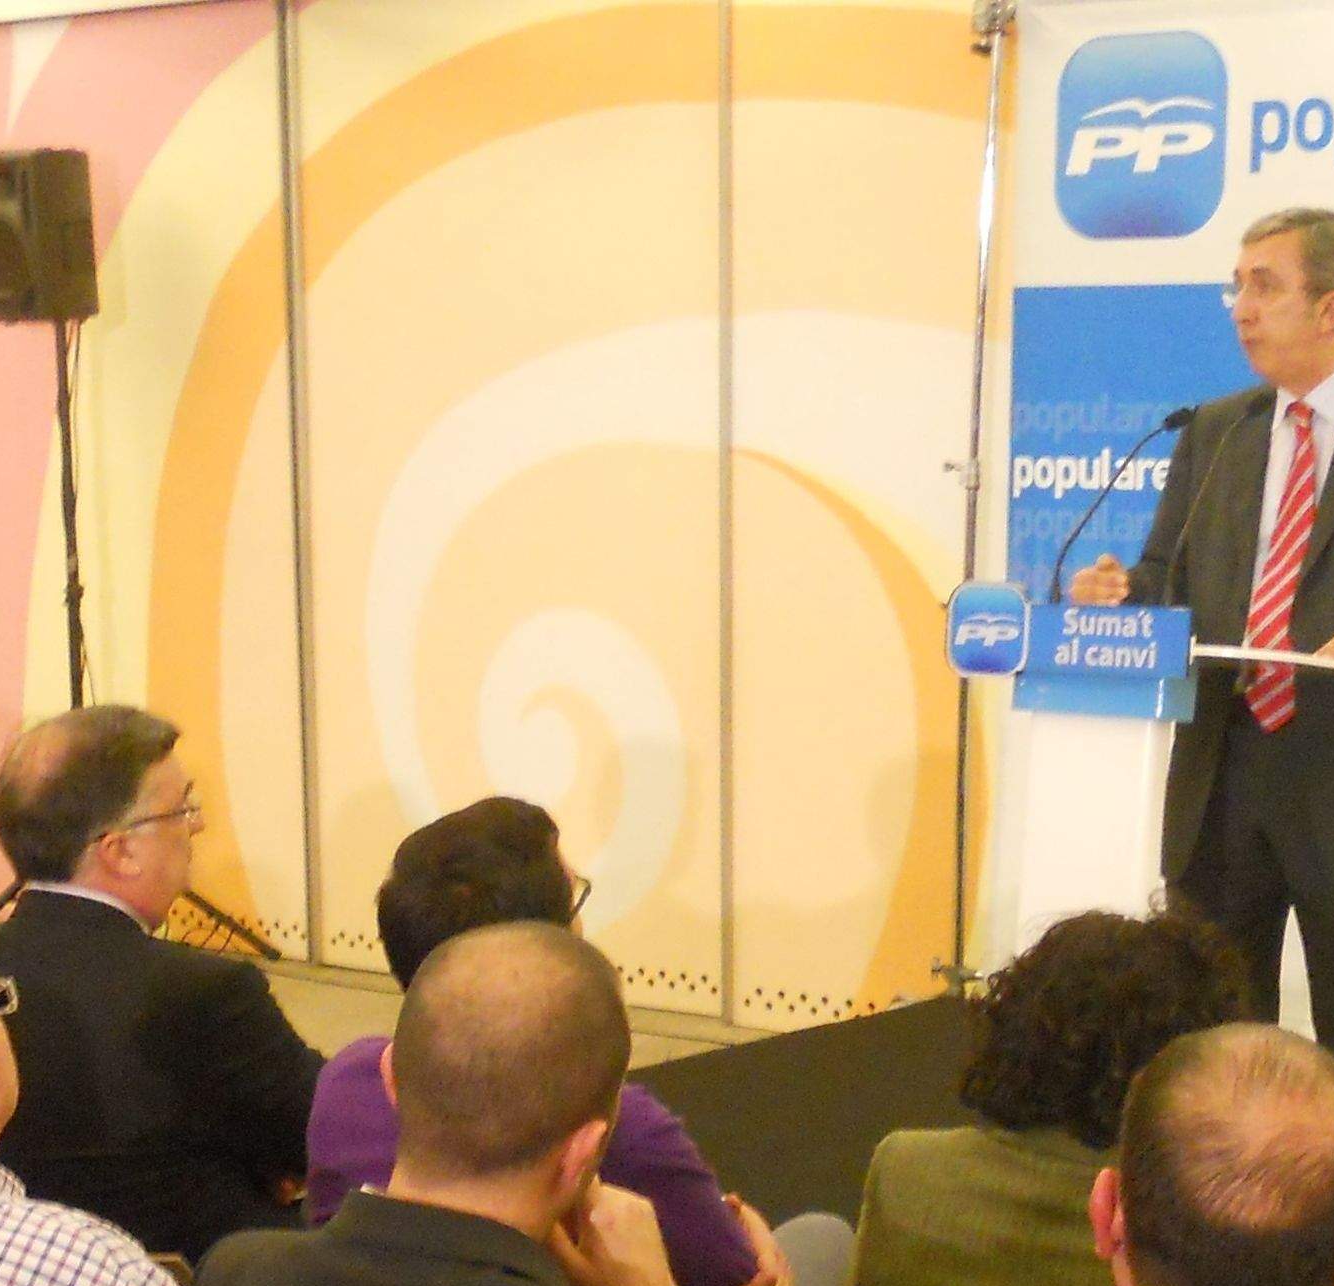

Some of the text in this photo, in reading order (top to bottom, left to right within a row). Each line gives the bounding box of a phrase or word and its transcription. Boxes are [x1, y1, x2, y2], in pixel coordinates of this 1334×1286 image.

[1066, 123, 1214, 176] PP
[1013, 446, 1173, 499] populare
[1054, 637, 1157, 669] al canvi
